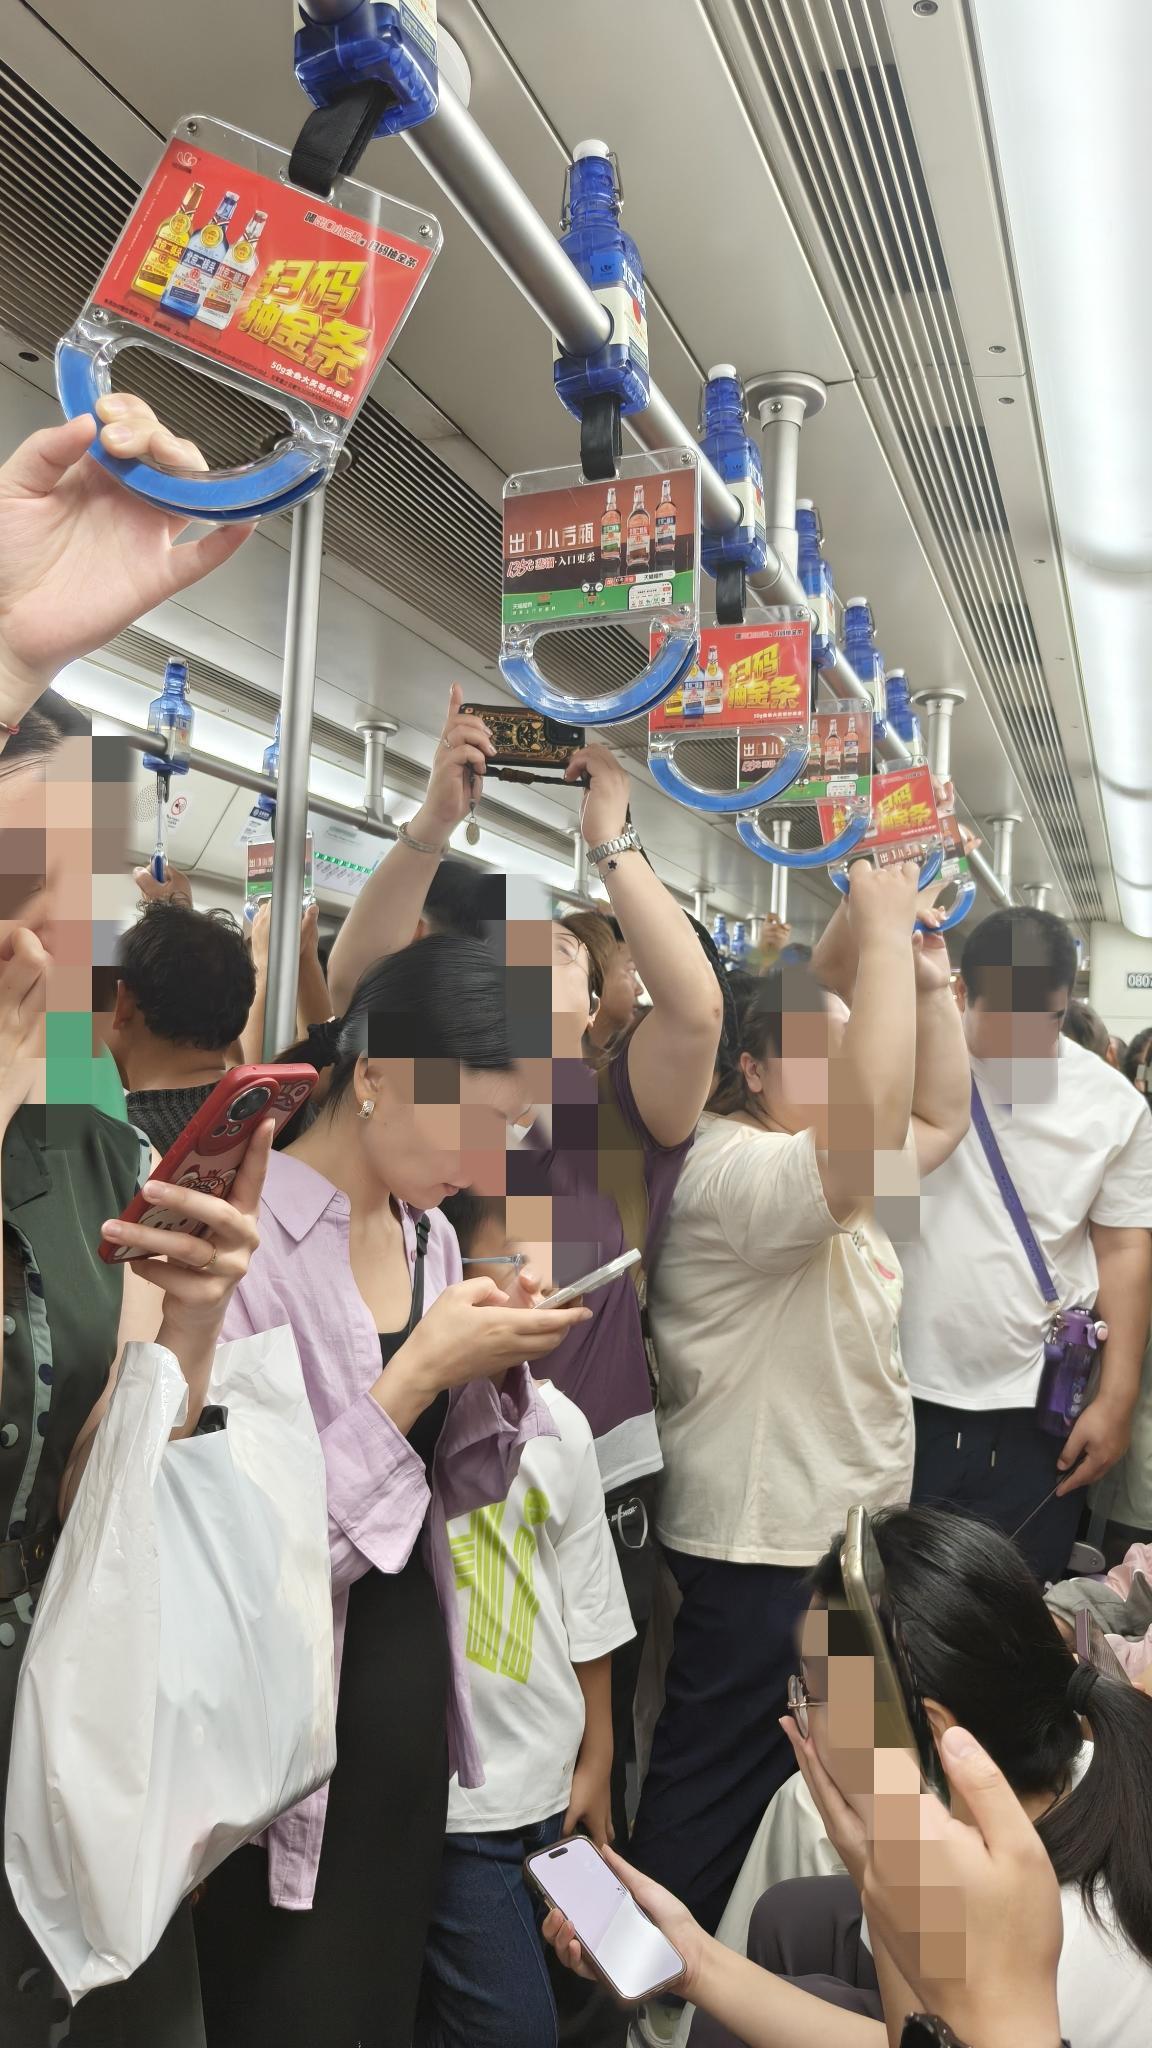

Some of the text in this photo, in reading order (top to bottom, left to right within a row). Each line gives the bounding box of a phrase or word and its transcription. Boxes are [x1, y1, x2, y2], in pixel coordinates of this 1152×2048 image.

[256, 260, 368, 317] 扫码
[238, 299, 372, 387] 抽金条
[509, 522, 594, 553] 出口小方瓶
[728, 643, 779, 681] 扫码
[728, 675, 801, 709] 抽金条
